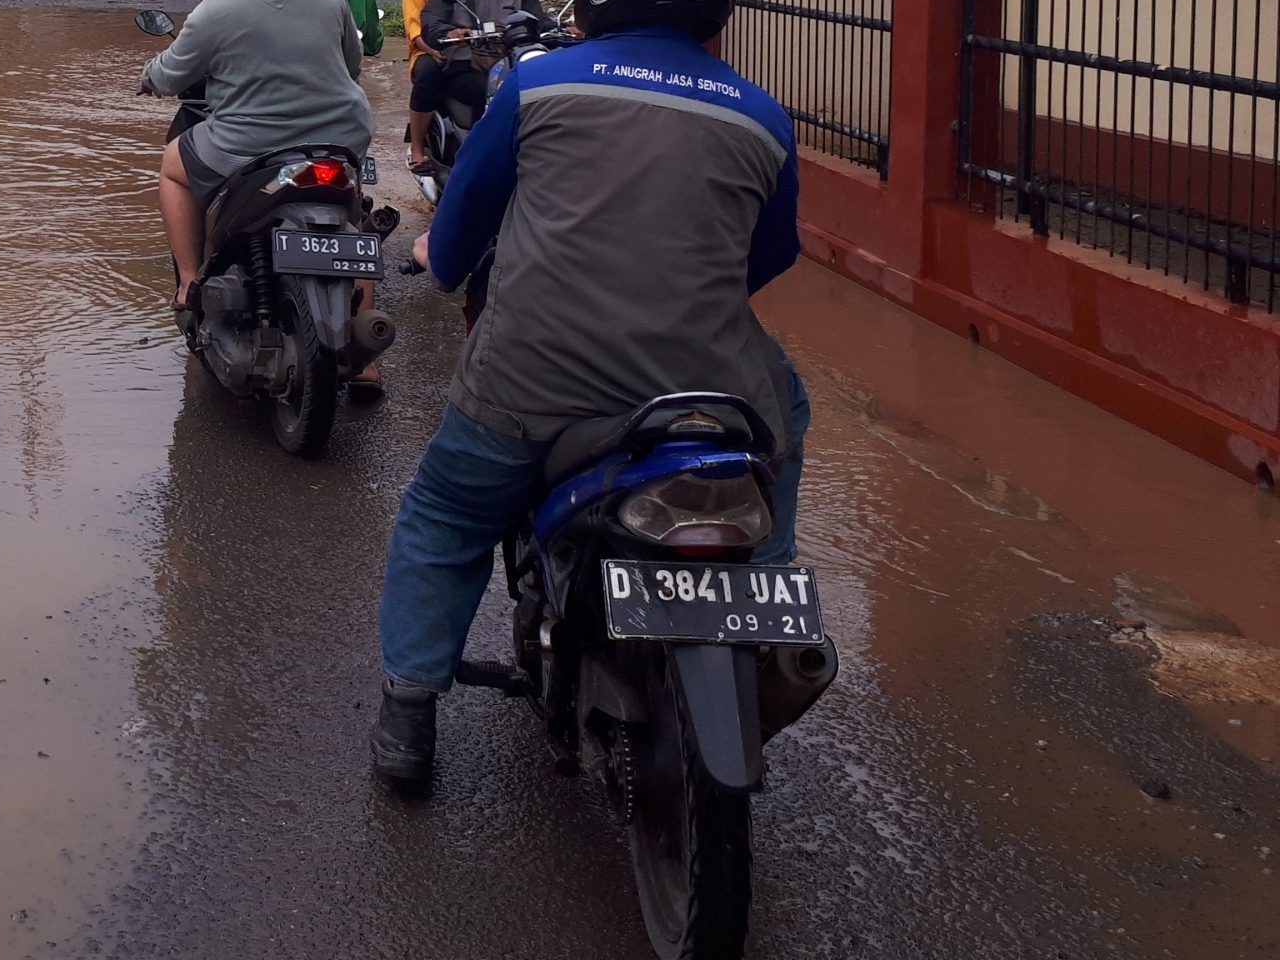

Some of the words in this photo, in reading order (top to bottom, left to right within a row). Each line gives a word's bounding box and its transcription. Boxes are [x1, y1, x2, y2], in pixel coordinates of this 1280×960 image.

[592, 63, 610, 75] PT.
[613, 64, 663, 83] ANUGRAH
[666, 72, 693, 87] JASA
[697, 77, 741, 100] SENTOSA
[279, 235, 289, 251] T
[301, 237, 340, 254] 3623
[356, 240, 376, 256] CJ
[610, 566, 631, 600] D
[656, 569, 733, 603] 3841
[749, 572, 809, 606] UAT
